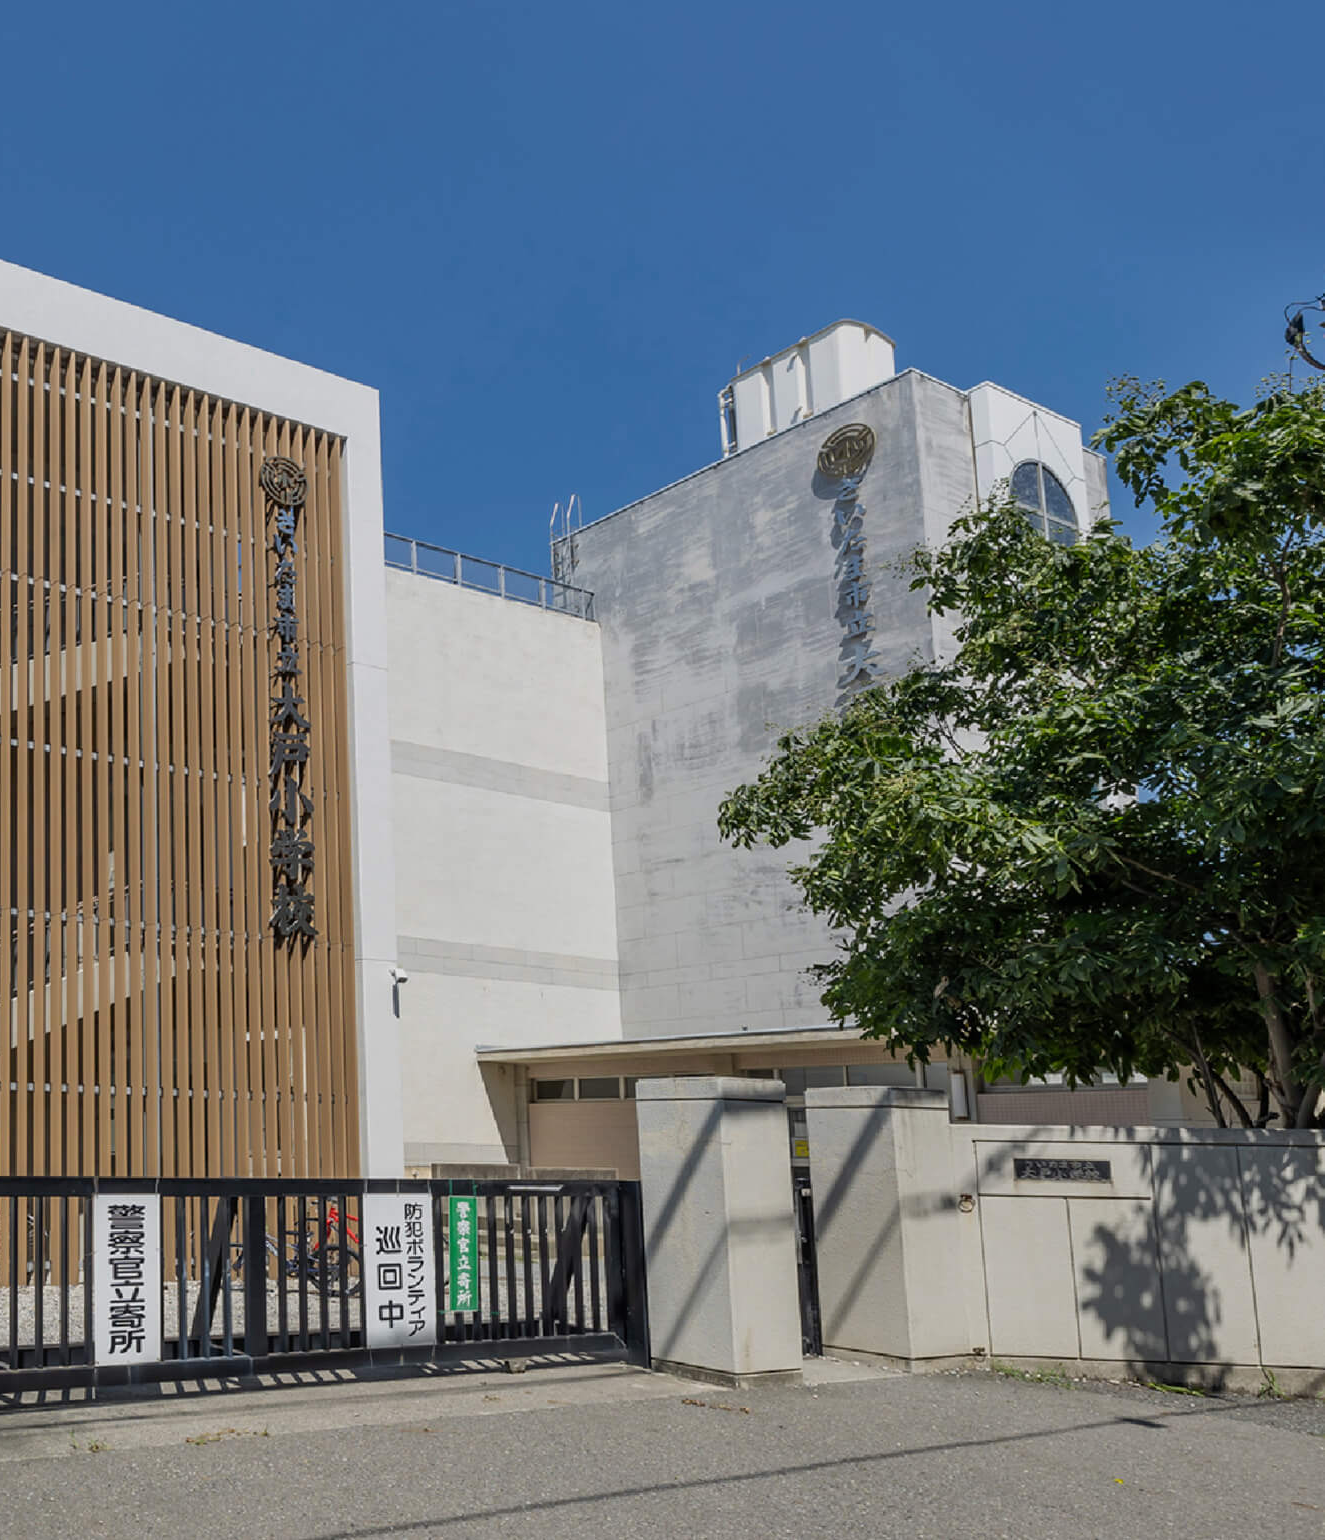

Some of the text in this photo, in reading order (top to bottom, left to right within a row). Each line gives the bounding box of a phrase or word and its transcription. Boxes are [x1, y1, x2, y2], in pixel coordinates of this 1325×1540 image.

[269, 505, 317, 936] さいたま市立大戸小学校
[108, 1204, 145, 1354] 警察官立寄所
[376, 1226, 403, 1329] 巡回中
[404, 1203, 426, 1337] 防犯ボランティア
